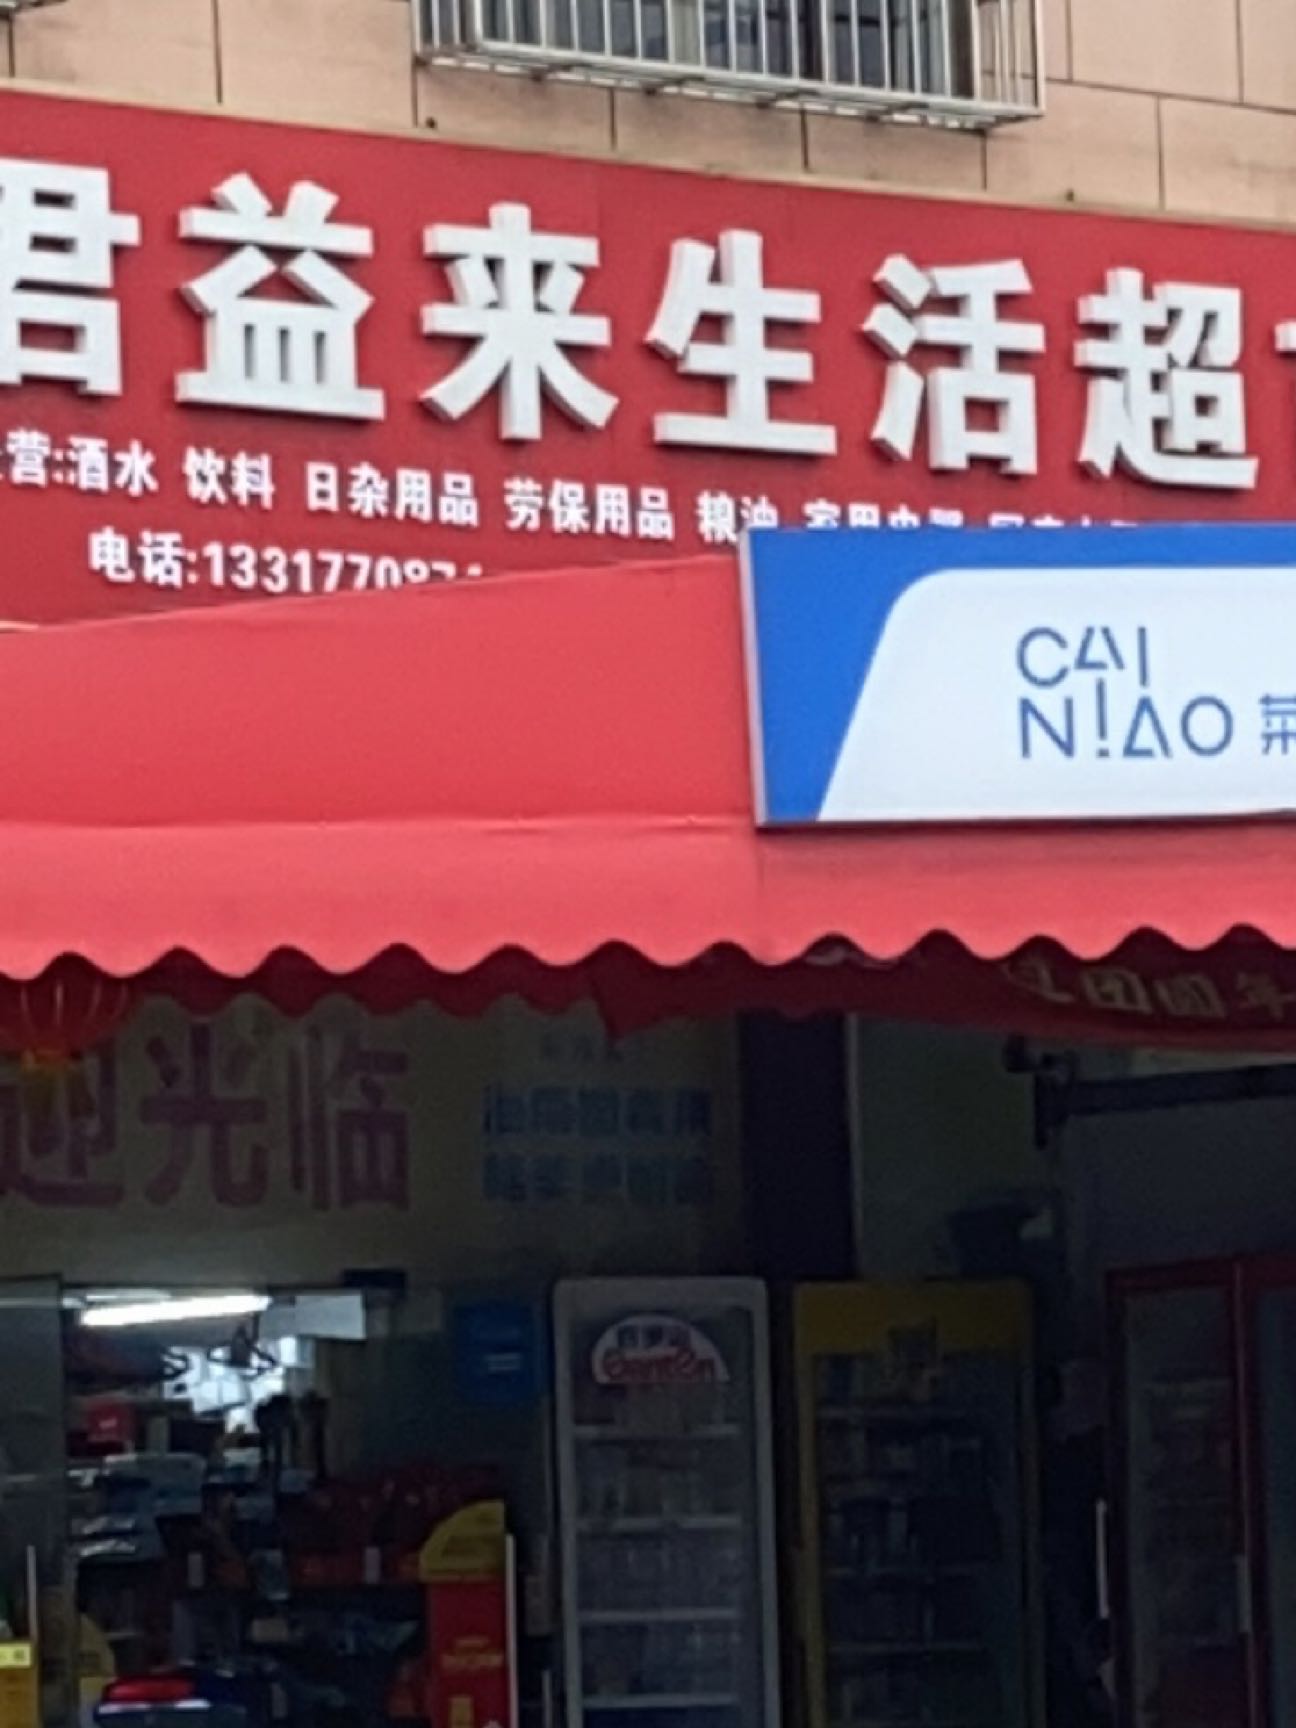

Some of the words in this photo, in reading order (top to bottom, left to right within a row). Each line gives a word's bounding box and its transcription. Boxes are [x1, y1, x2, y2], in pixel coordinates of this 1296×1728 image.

[0, 430, 159, 497] 营:酒水
[182, 447, 275, 511] 饮料
[305, 461, 480, 527] 日杂用品
[504, 478, 675, 540] 劳保用品
[1016, 626, 1149, 688] CAI
